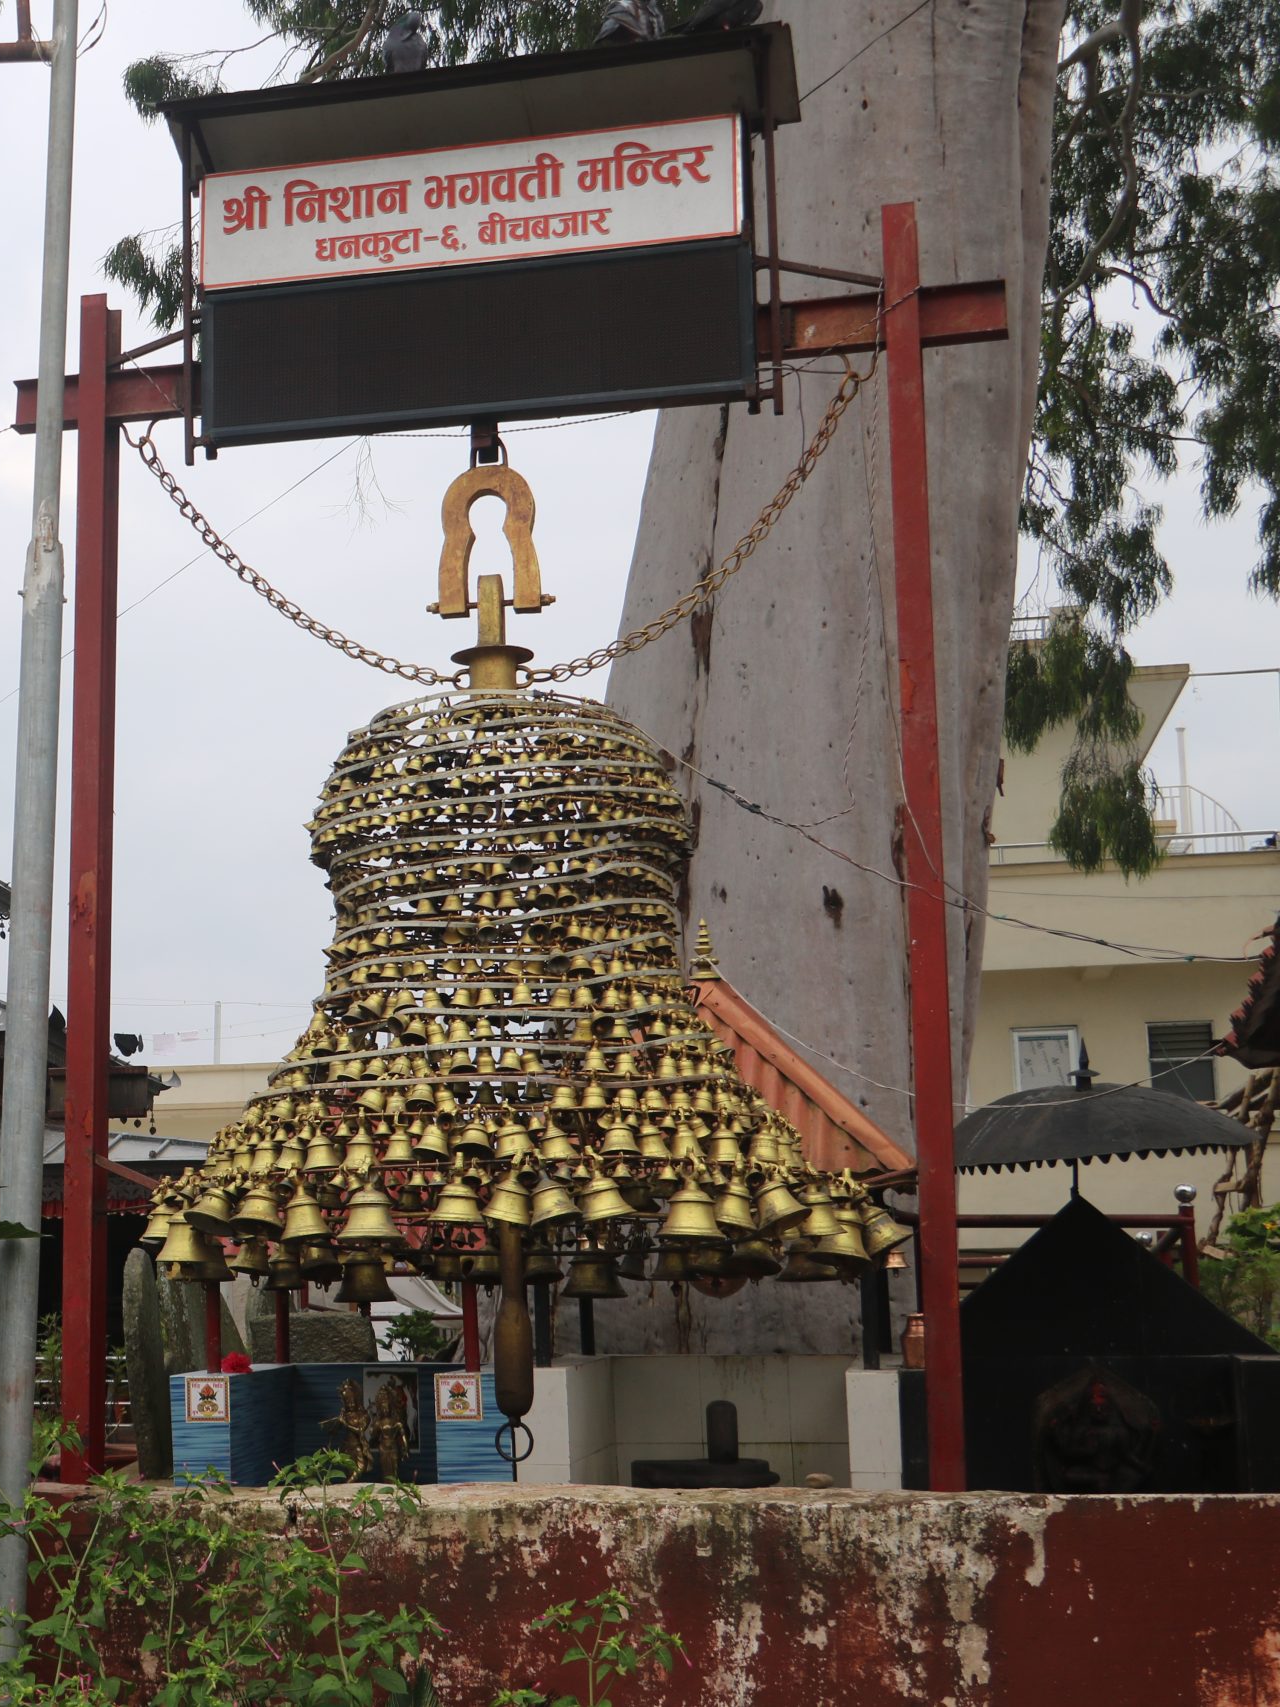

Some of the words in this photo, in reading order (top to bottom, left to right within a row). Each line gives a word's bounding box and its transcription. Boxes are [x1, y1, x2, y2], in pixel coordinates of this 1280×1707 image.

[222, 185, 272, 235] श्री
[283, 178, 412, 226] निशान
[423, 152, 565, 210] भगवती
[577, 141, 714, 192] मन्दिर
[478, 207, 613, 245] बीचबजार
